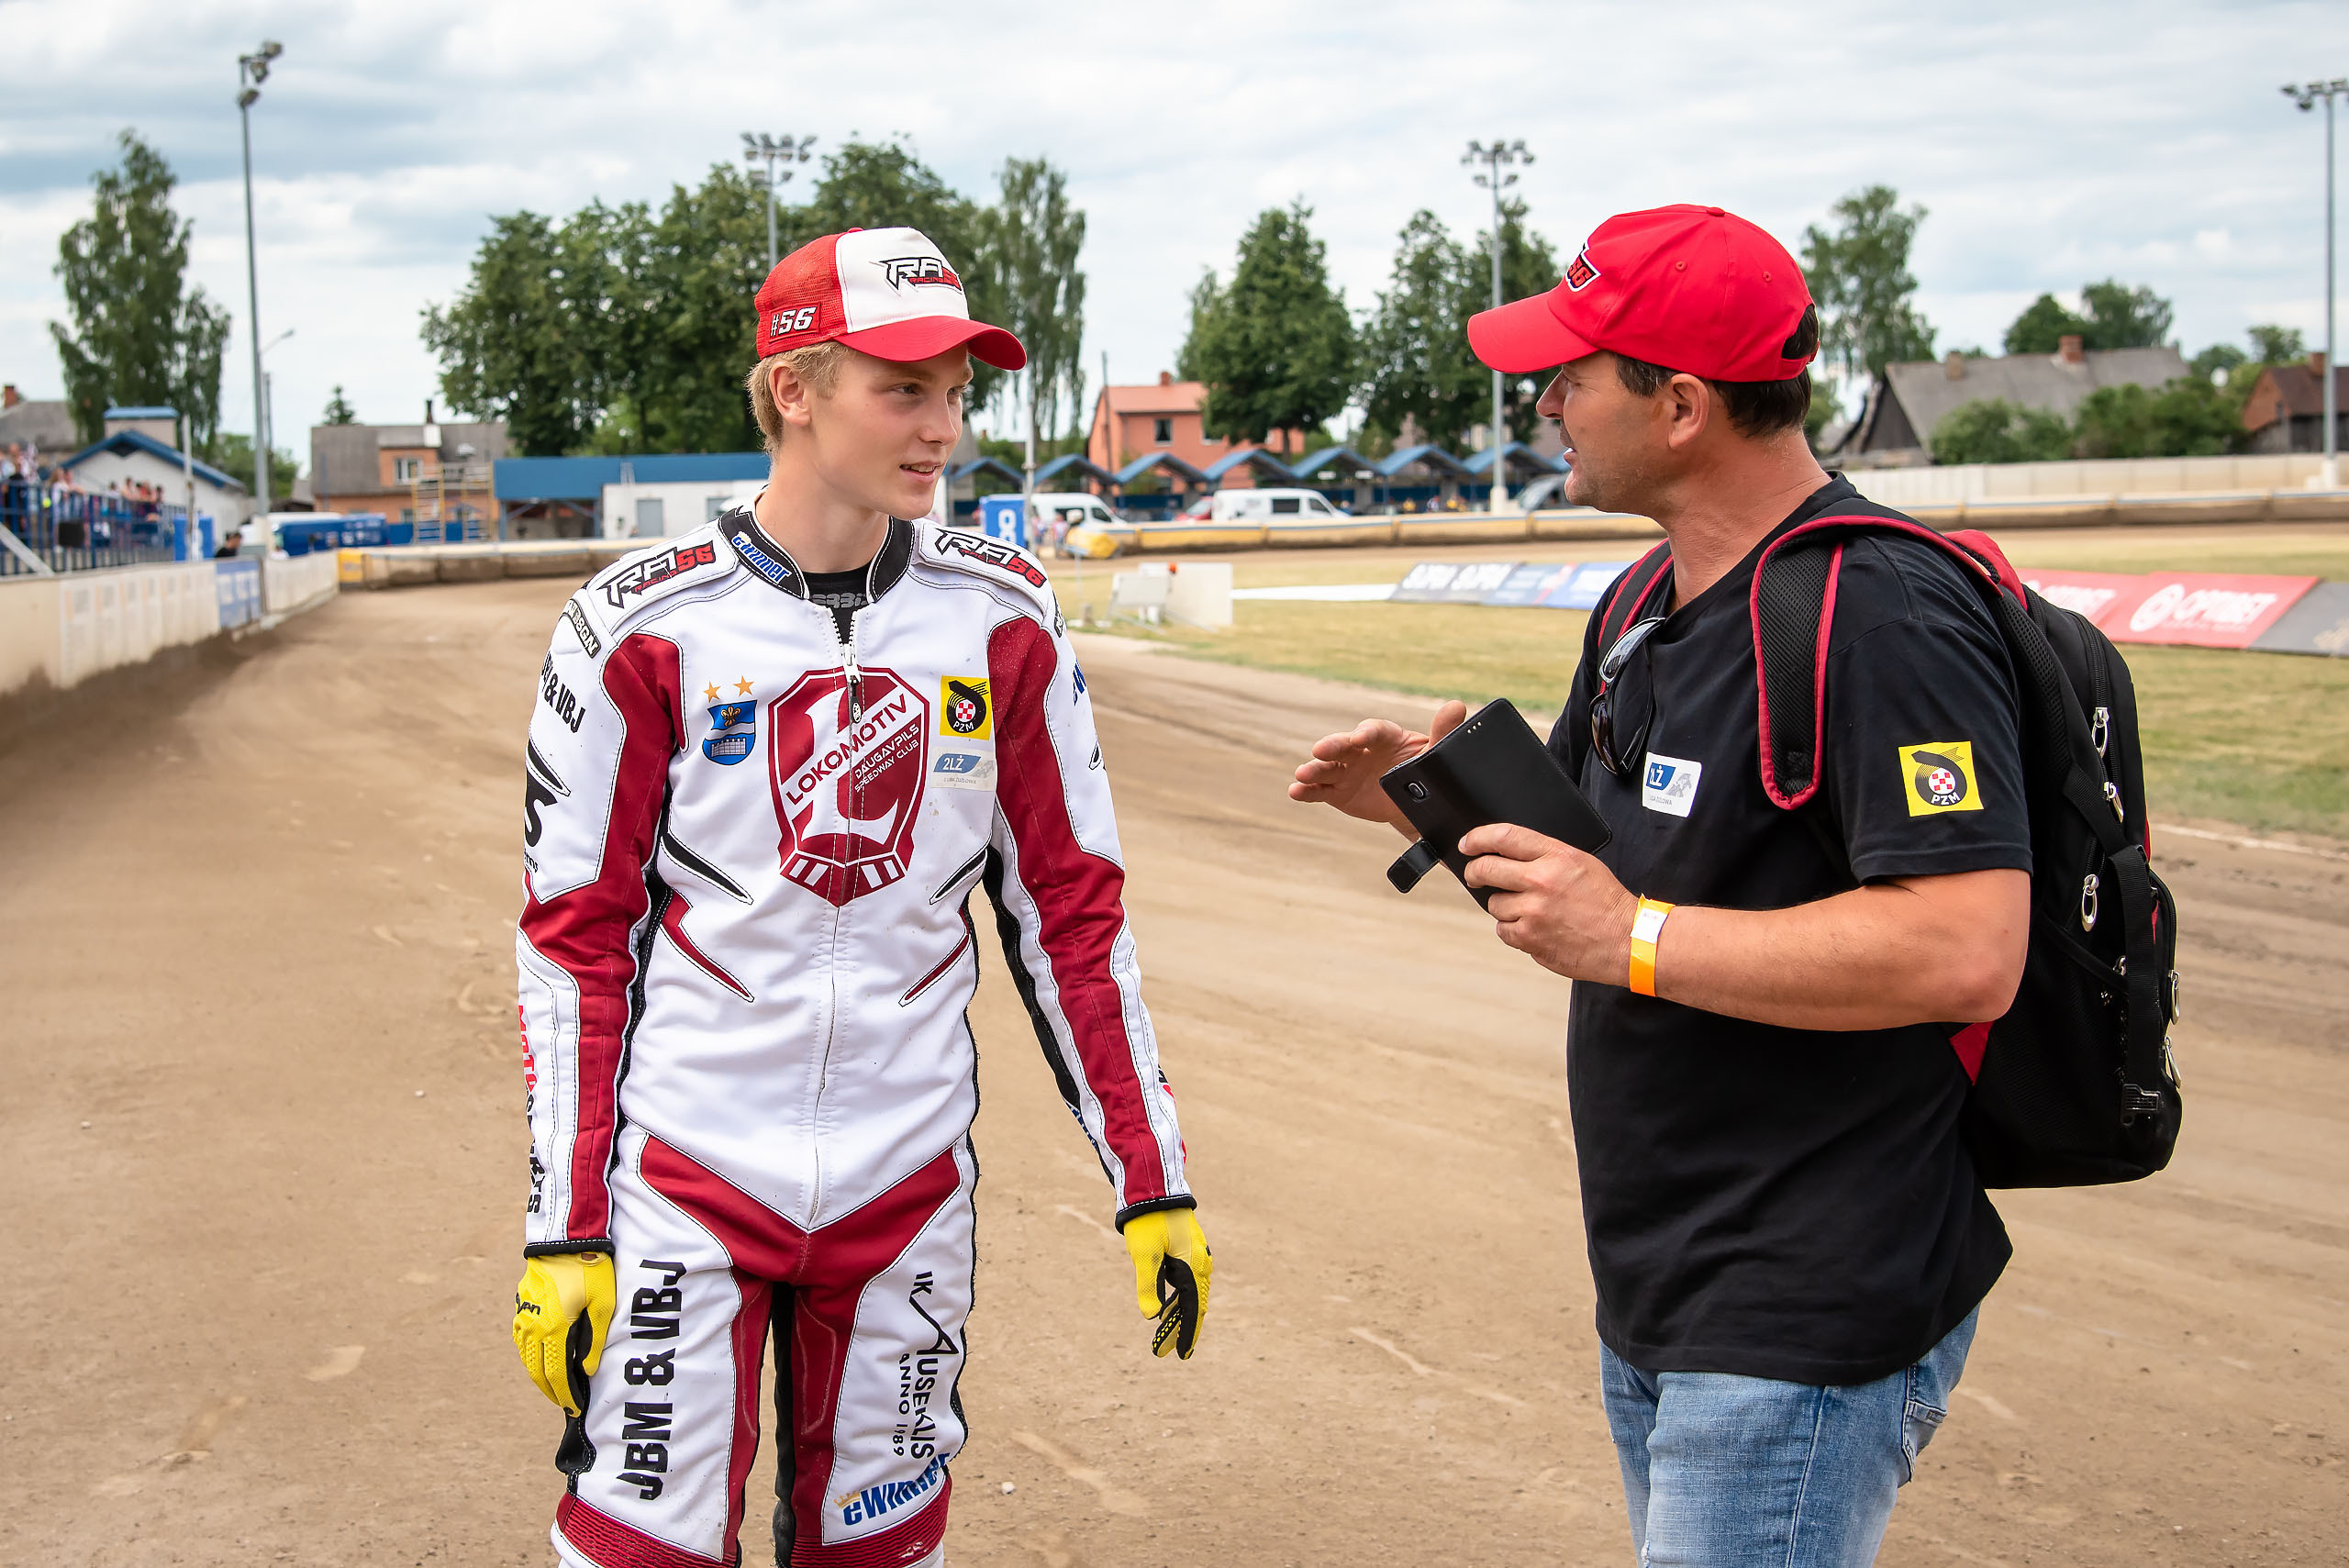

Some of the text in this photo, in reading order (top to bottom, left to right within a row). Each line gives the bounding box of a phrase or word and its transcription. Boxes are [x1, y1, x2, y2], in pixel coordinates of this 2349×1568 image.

[770, 306, 817, 337] #56
[555, 683, 586, 733] VBJ
[952, 720, 974, 732] PZM
[785, 693, 908, 806] LOKOMOTIV
[854, 723, 919, 779] DAUGAVPILS
[854, 740, 919, 793] SPEEDWAY CLUB
[942, 754, 964, 772] 2LŻ
[1931, 792, 1961, 806] PZM
[616, 1259, 687, 1501] JBM & VBJ
[898, 1352, 912, 1415] ANNO
